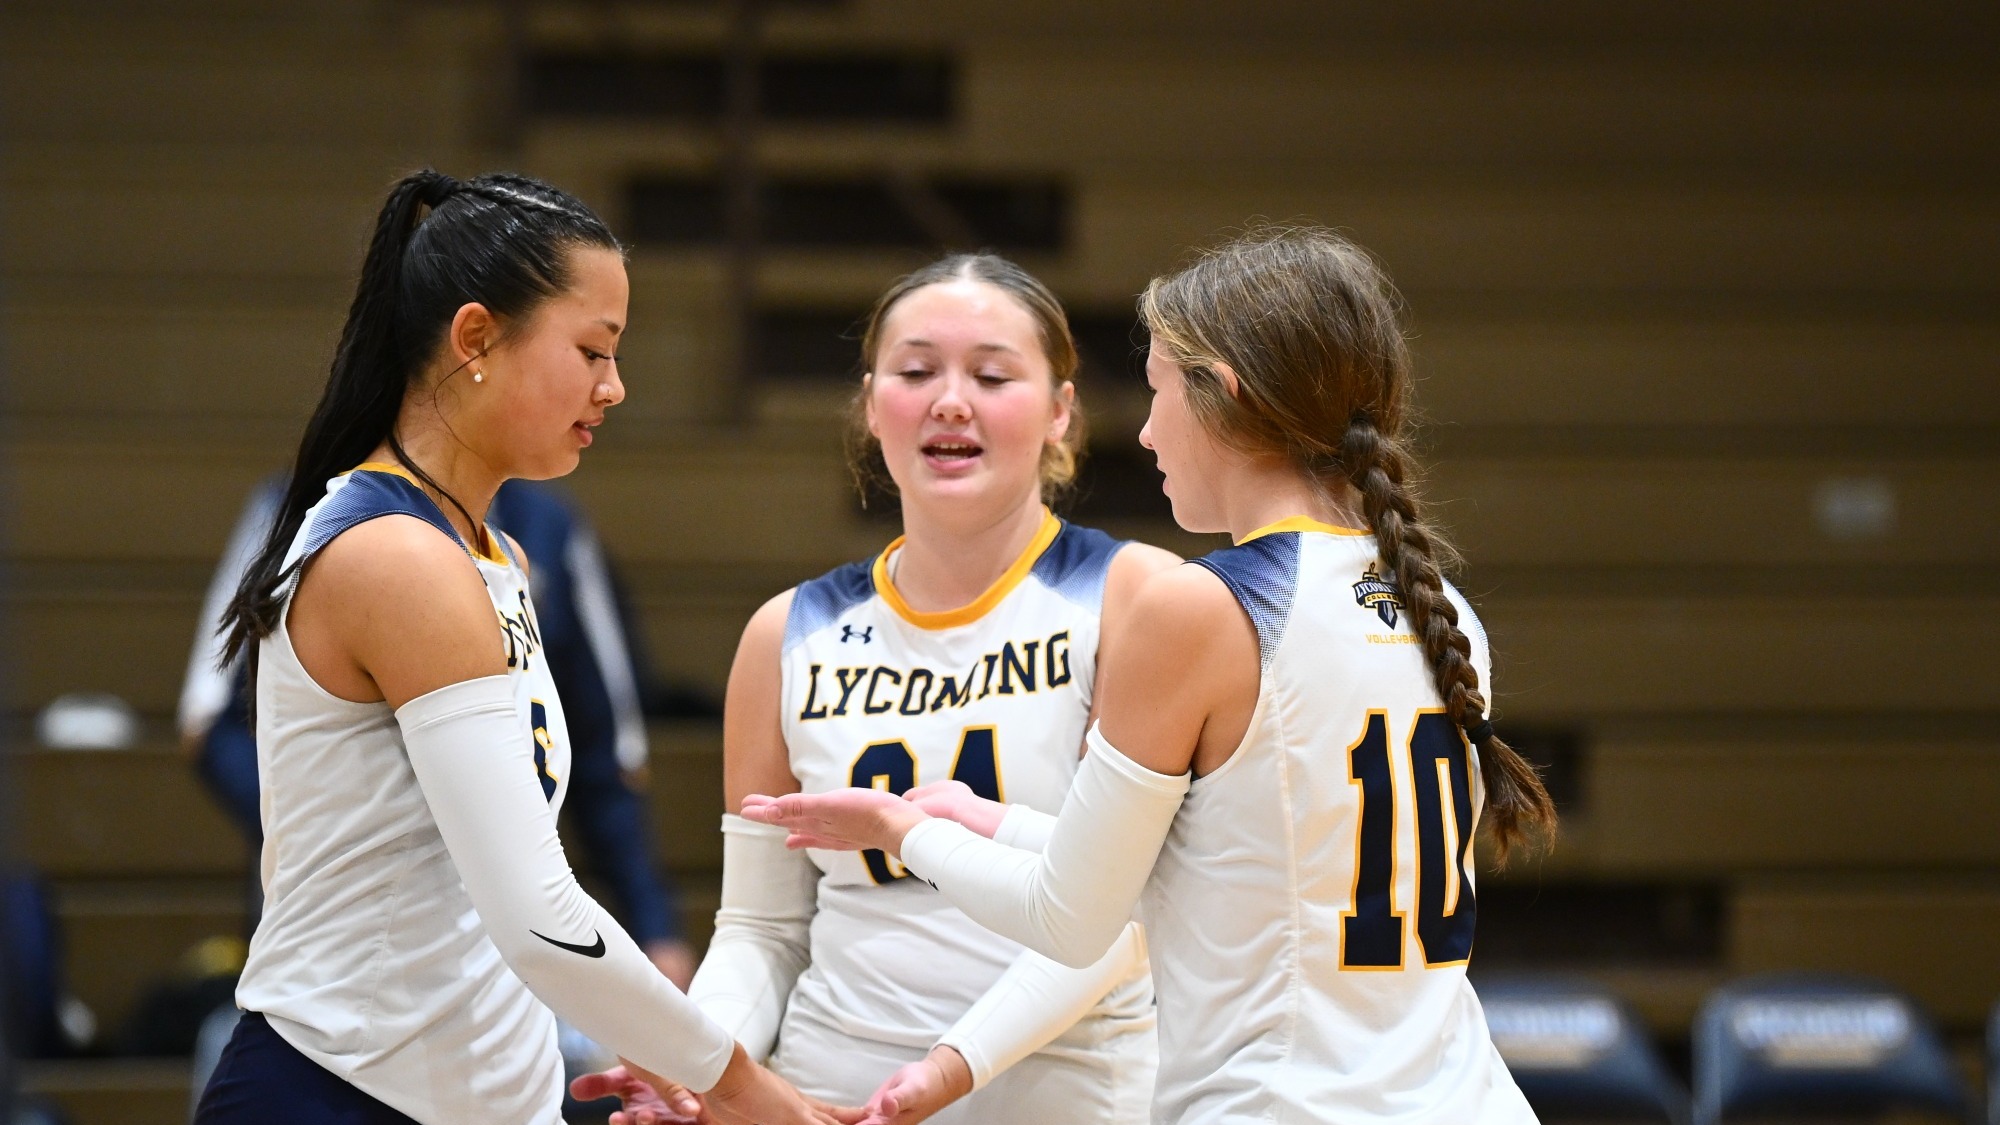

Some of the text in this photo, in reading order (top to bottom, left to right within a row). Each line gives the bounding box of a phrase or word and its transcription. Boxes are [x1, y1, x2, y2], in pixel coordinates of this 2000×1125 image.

[1367, 593, 1399, 602] COLLEG
[1366, 633, 1423, 645] VOLLEYBAL
[799, 629, 1073, 721] LYCOMING
[1338, 708, 1476, 971] 10
